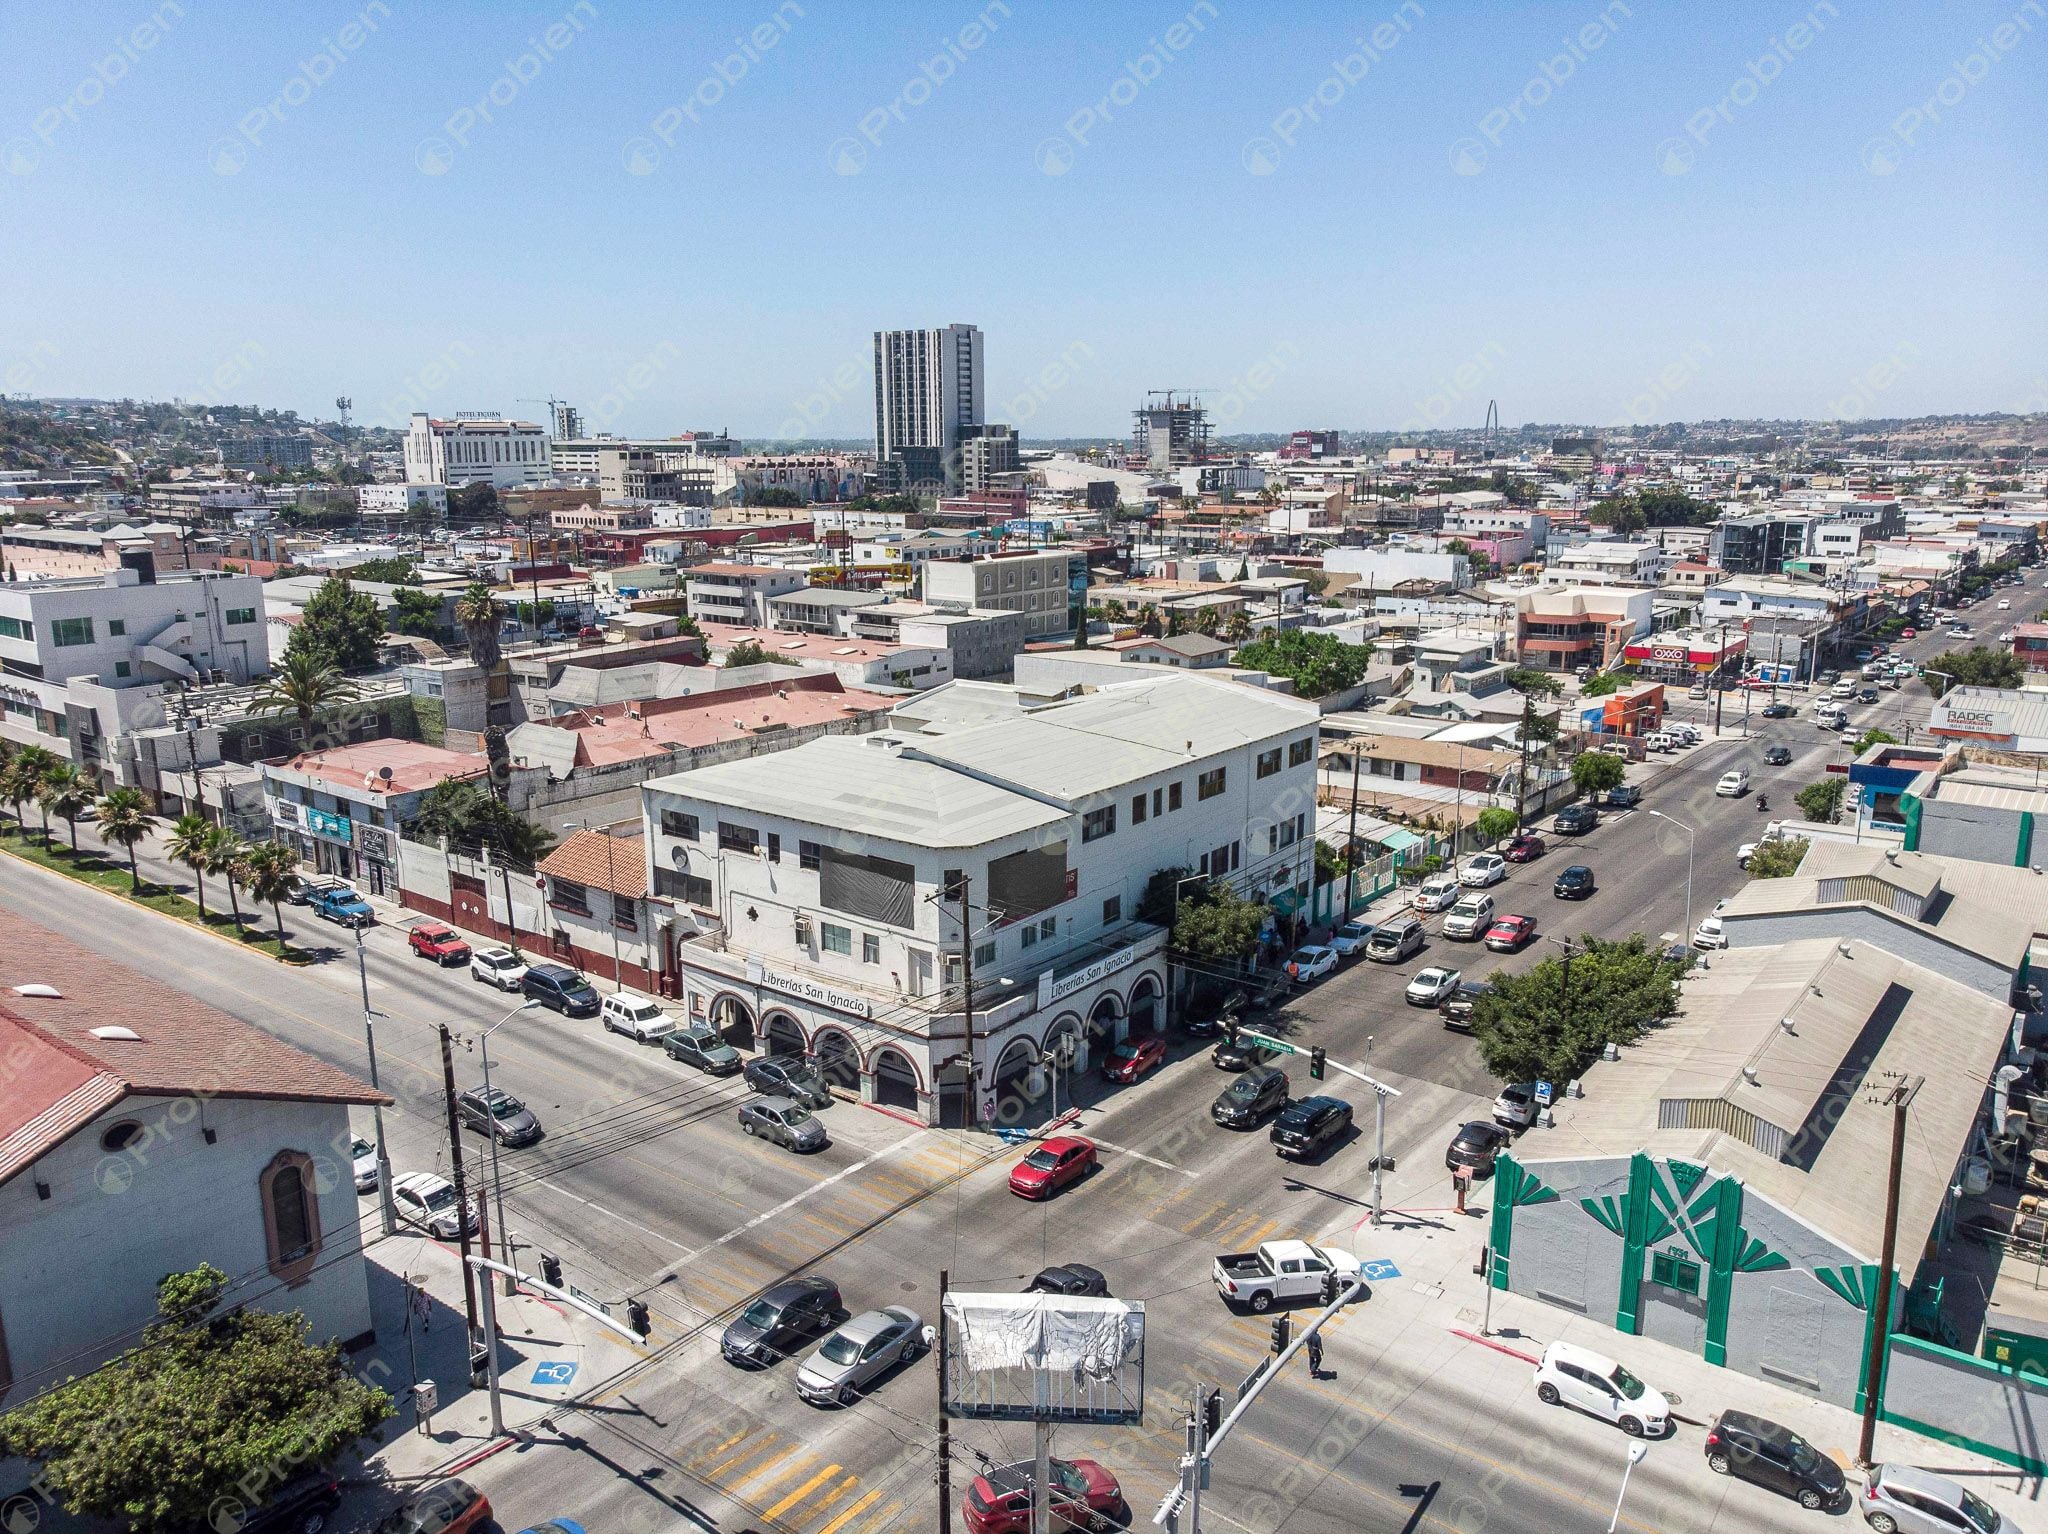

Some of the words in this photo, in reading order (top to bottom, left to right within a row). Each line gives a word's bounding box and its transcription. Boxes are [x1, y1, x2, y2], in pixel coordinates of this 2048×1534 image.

[1654, 648, 1683, 660] OXXO
[1947, 710, 1994, 723] RADEC
[1087, 967, 1101, 980] San
[1103, 951, 1132, 974] Ignacio
[805, 984, 823, 999] San
[827, 991, 865, 1012] Ignacio
